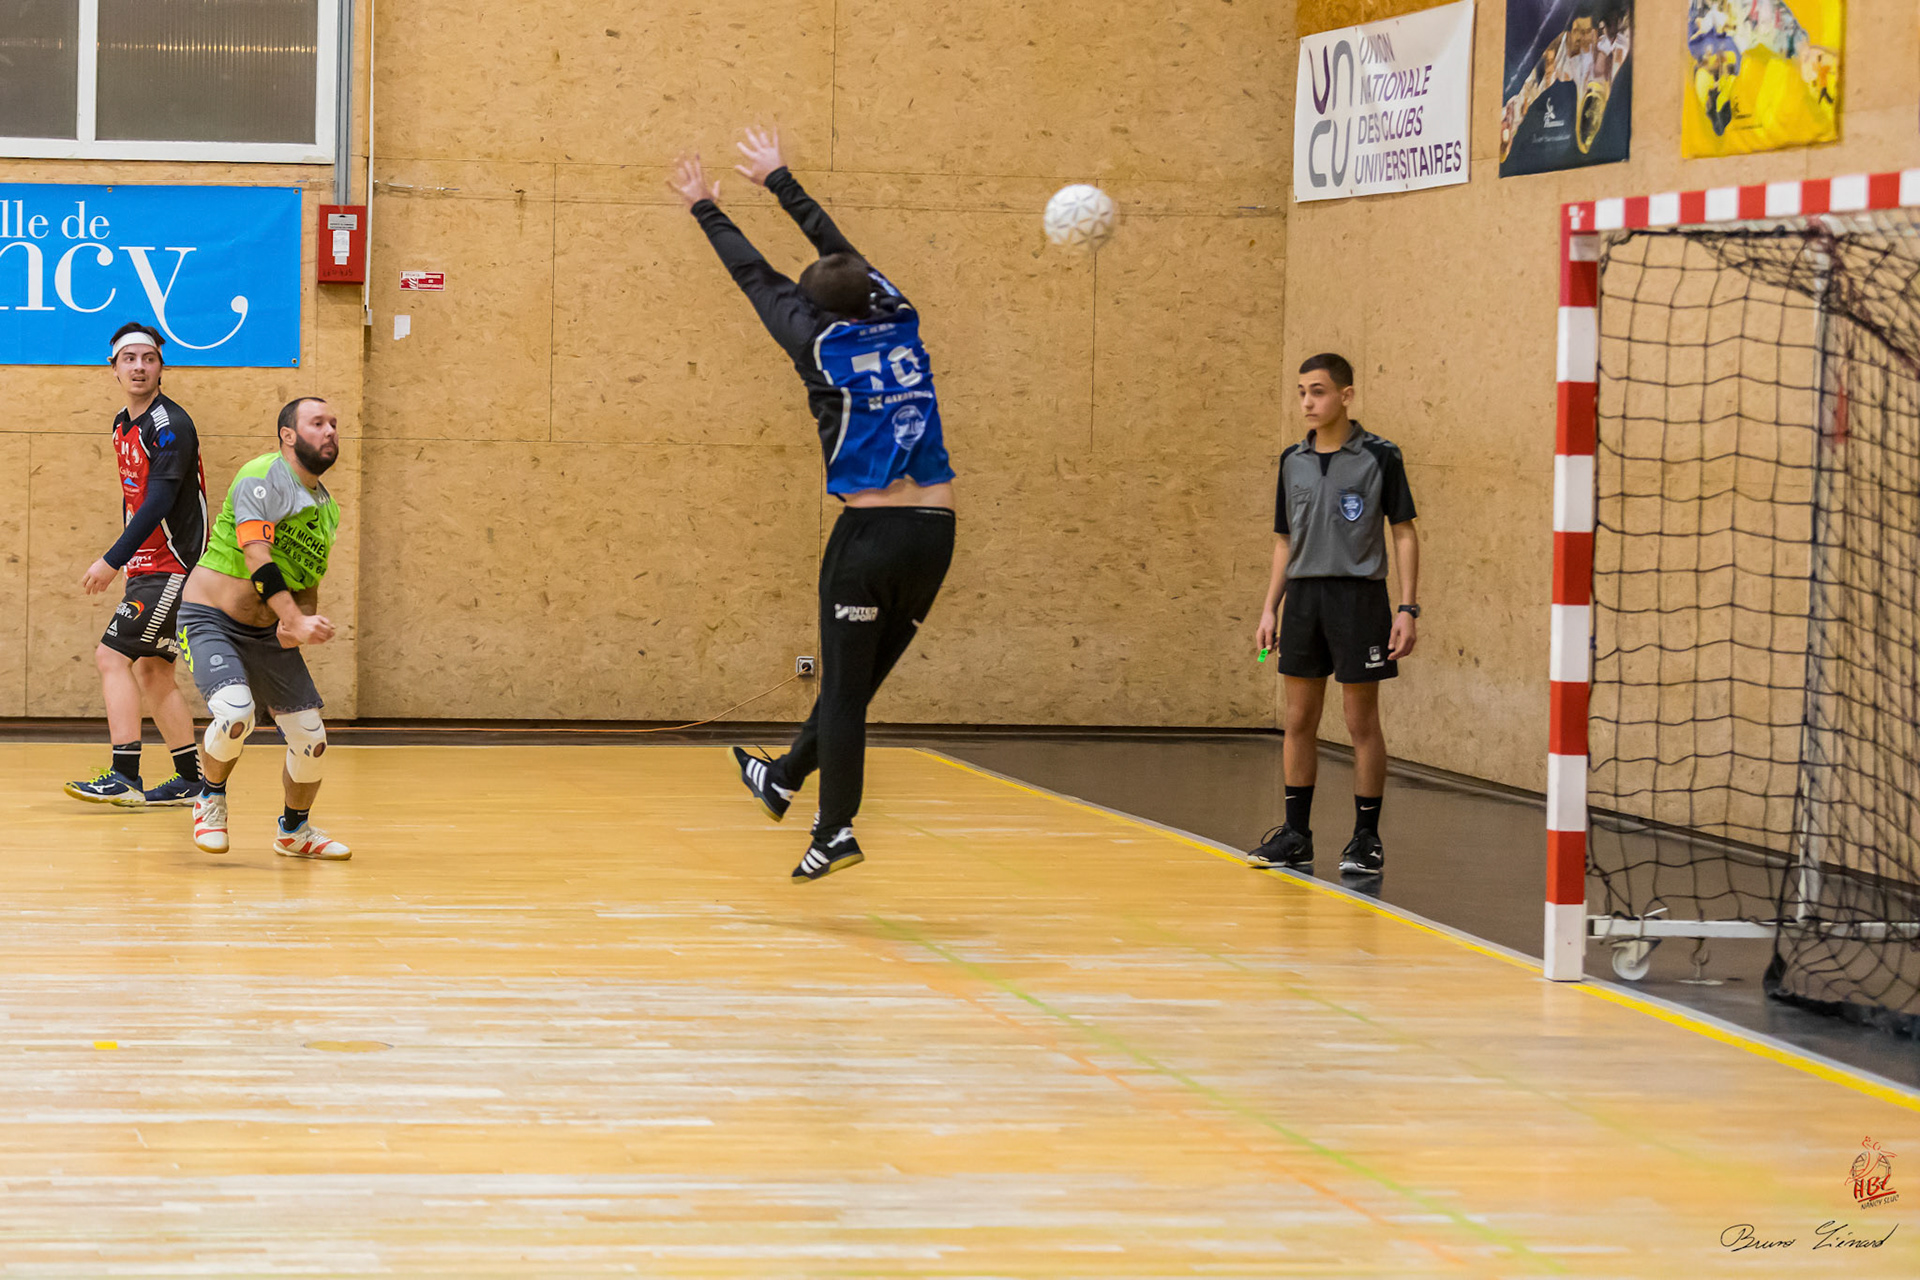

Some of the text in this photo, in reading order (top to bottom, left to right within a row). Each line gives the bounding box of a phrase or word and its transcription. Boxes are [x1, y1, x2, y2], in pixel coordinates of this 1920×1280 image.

[1360, 32, 1395, 65] UNION
[1359, 64, 1432, 105] NATIONALE
[1357, 105, 1424, 145] DES CLUBS
[1354, 140, 1462, 184] UNIVERSITAIRES
[61, 201, 110, 239] de
[262, 524, 271, 540] C
